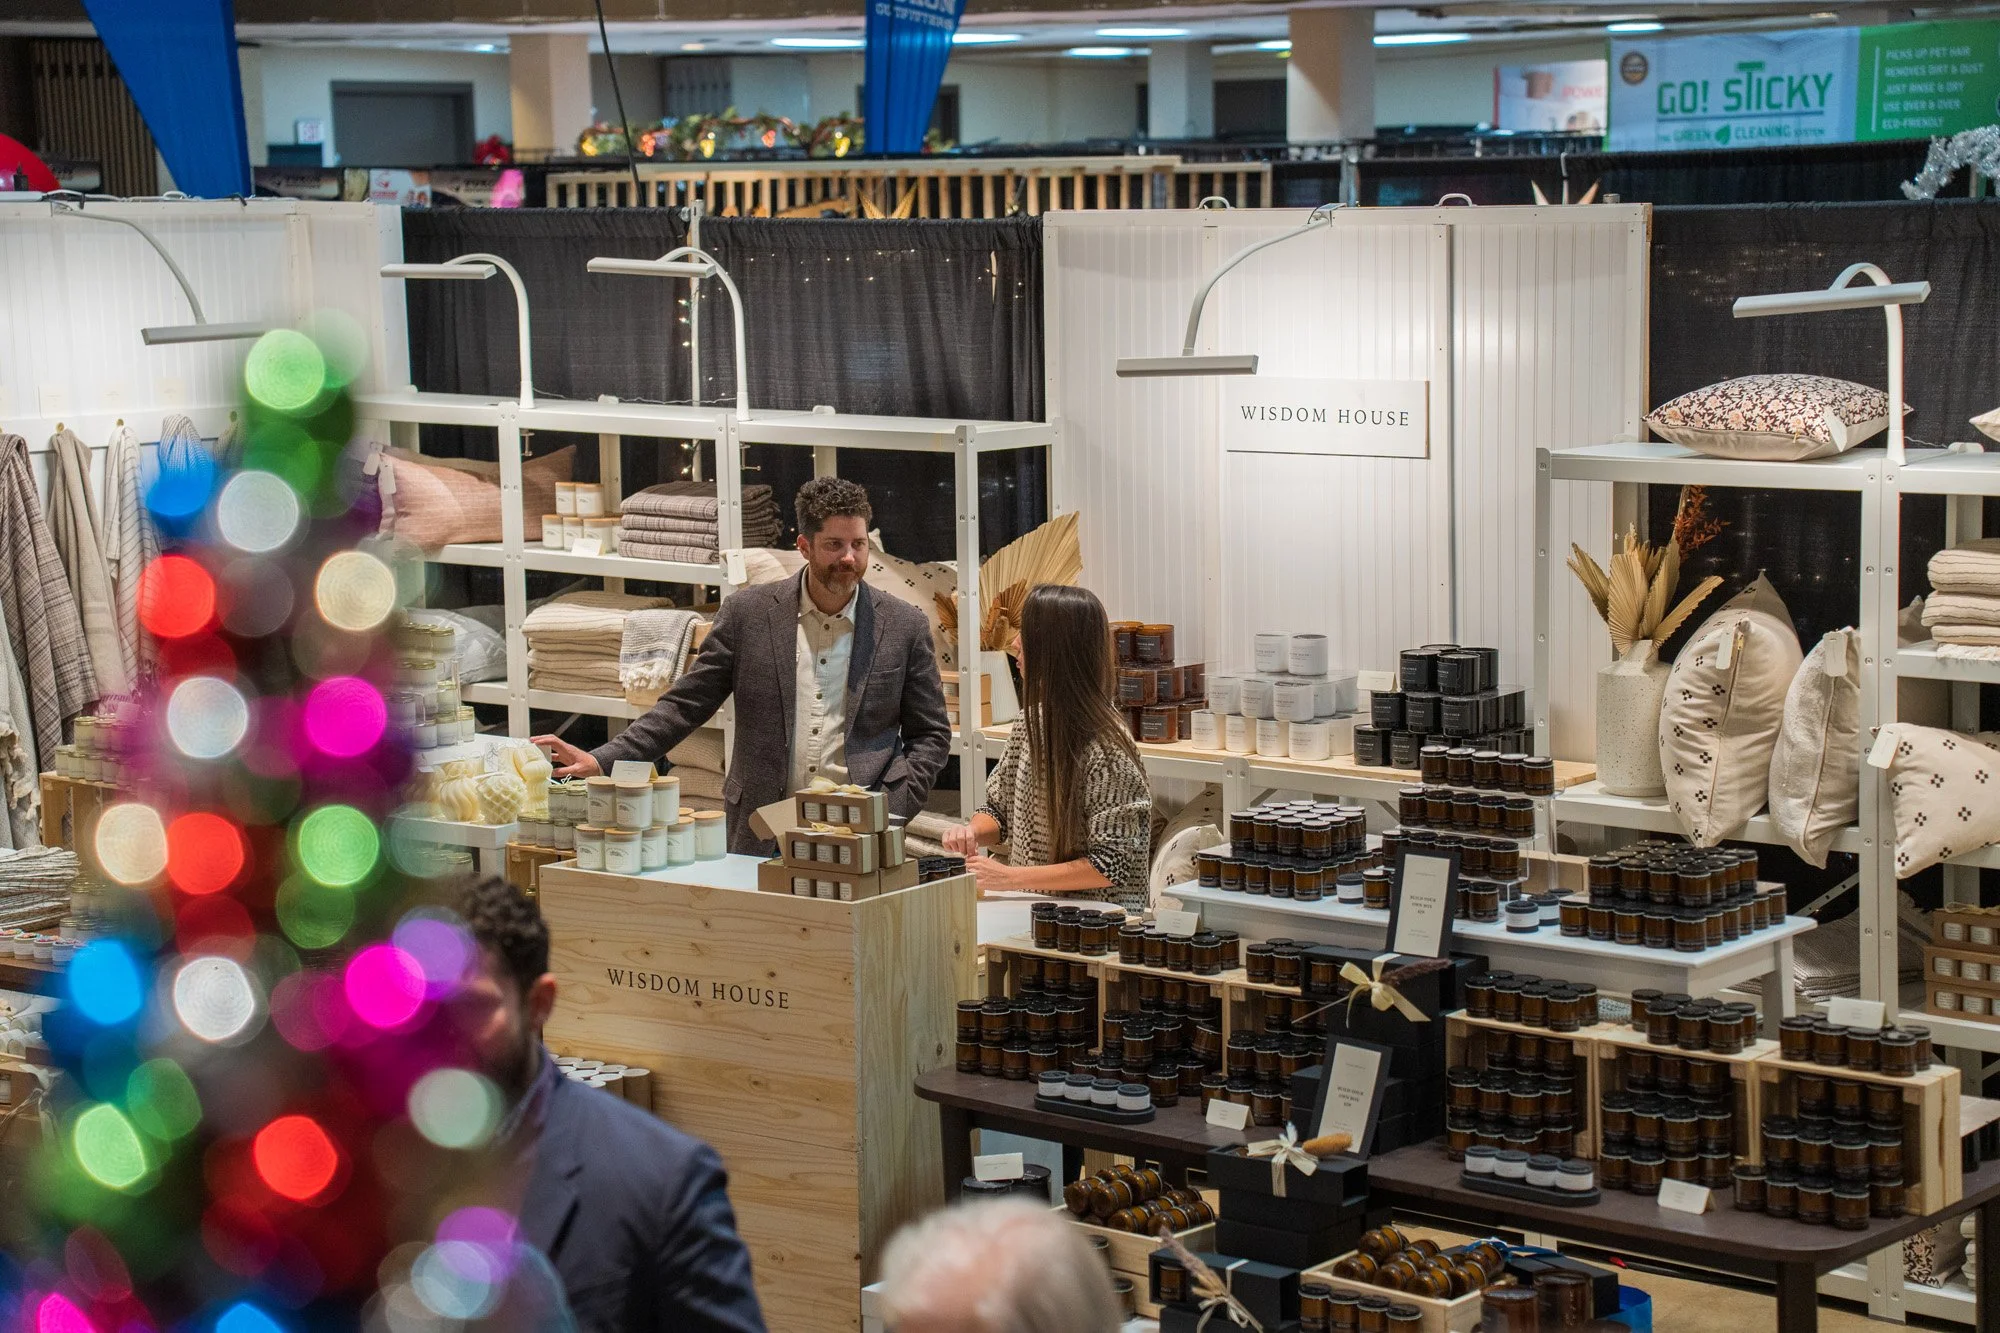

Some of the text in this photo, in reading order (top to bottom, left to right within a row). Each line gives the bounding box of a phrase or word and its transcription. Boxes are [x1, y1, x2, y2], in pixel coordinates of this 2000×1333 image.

[1657, 61, 1833, 114] GO! STICKY
[1673, 127, 1711, 142] GREEN
[1734, 125, 1790, 139] CLEANING
[1241, 406, 1409, 426] WISDOM HOUSE
[607, 968, 789, 1009] WISDOM HOUSE
